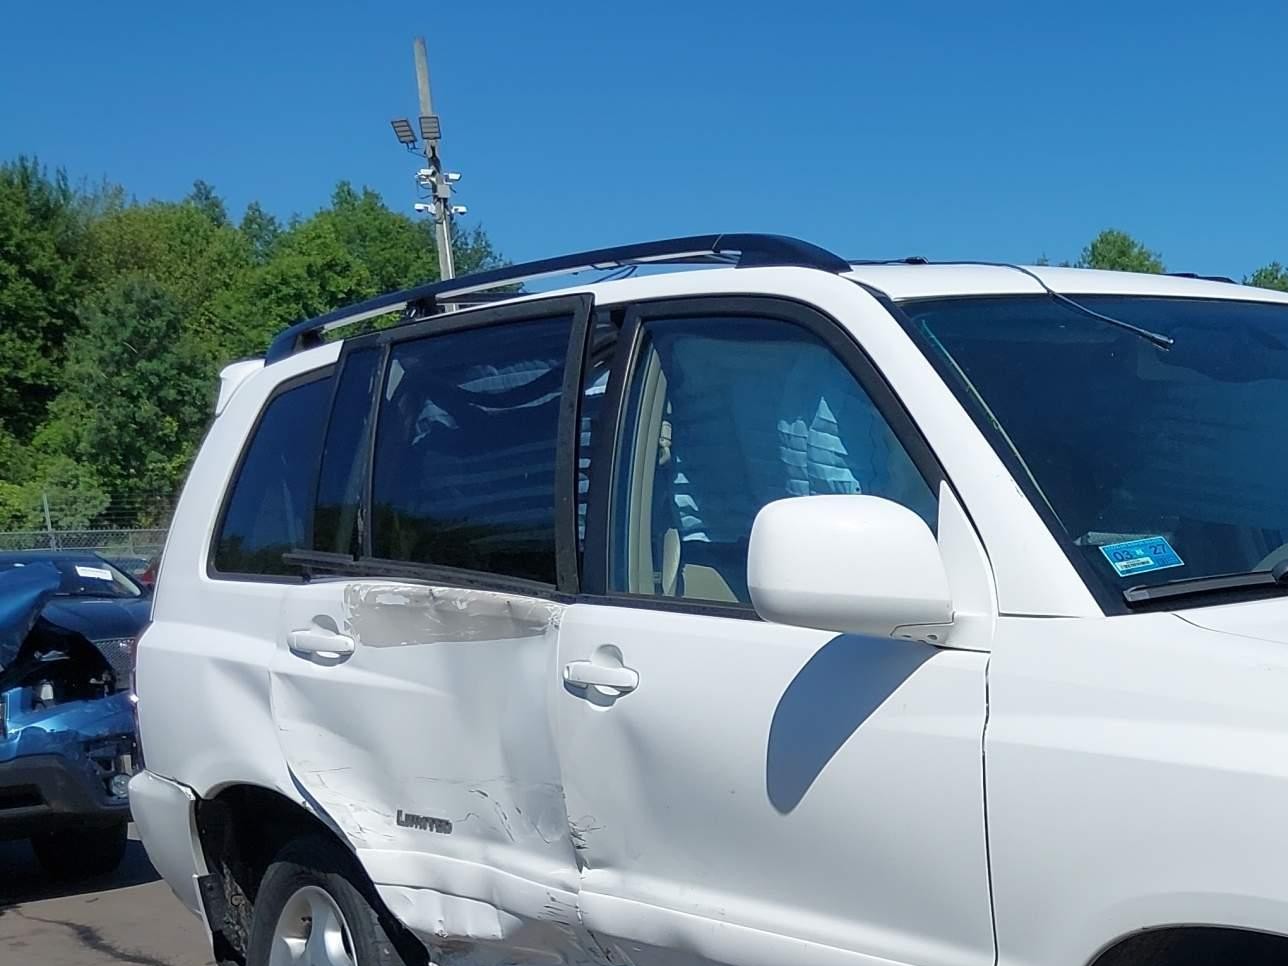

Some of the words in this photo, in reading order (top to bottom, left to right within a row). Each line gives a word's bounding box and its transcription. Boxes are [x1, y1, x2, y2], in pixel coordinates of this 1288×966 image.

[1113, 550, 1132, 562] 03
[1149, 544, 1167, 555] 27
[396, 808, 453, 834] LIMITED
